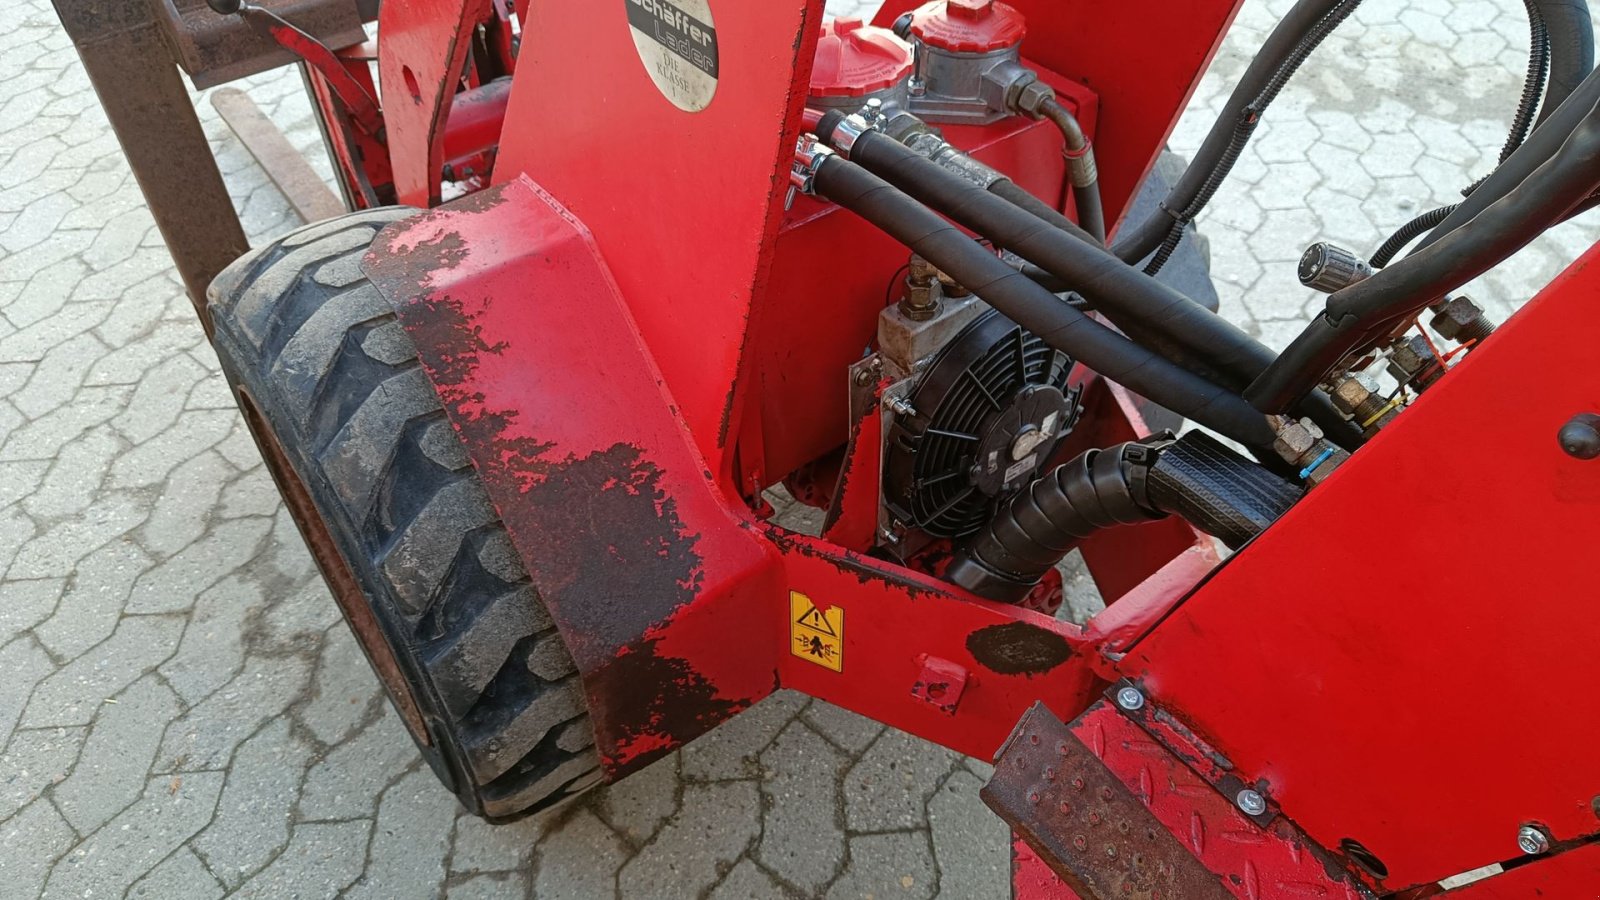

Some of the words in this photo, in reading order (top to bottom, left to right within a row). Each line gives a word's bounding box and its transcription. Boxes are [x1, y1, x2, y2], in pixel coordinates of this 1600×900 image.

[655, 19, 714, 71] Lader
[656, 62, 690, 94] KLASSE
[664, 53, 679, 72] DIE
